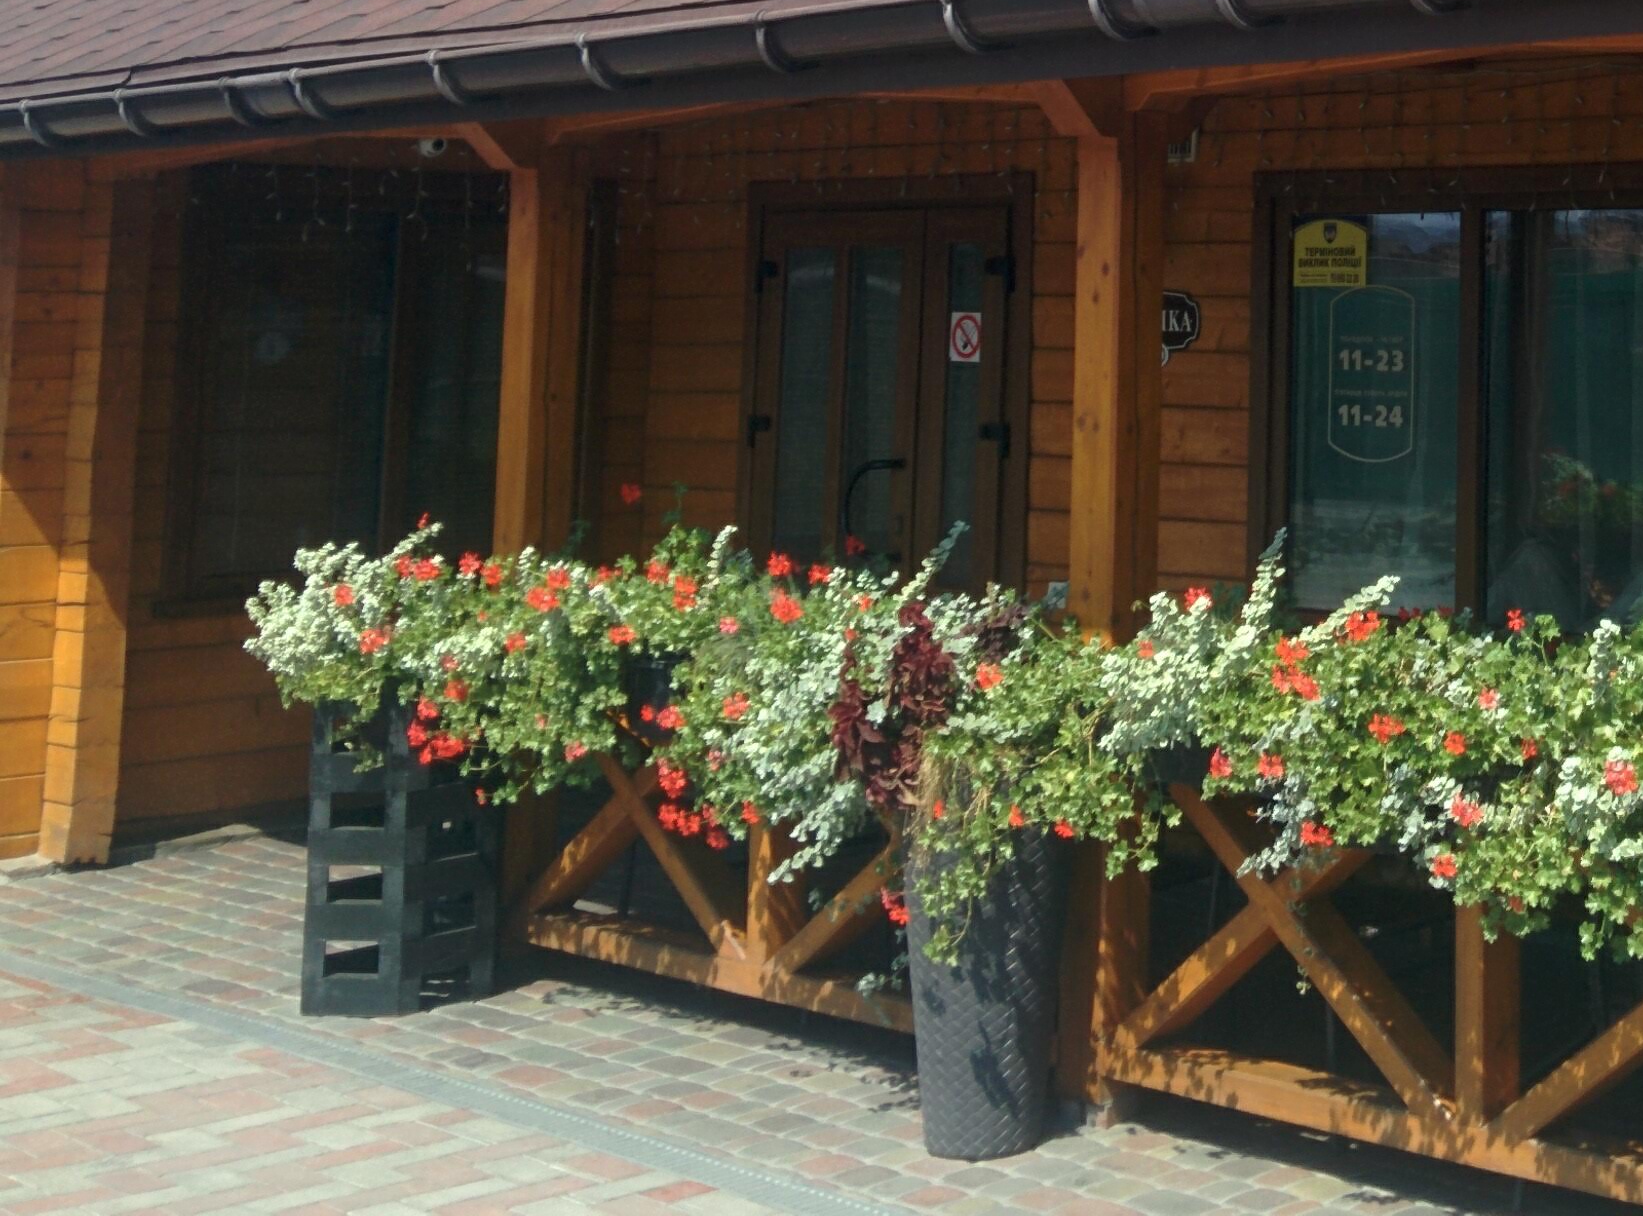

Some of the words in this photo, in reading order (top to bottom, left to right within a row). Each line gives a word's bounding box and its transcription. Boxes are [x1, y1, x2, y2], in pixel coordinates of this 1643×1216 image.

[1305, 245, 1356, 256] ТЕРМІНОВИЙ
[1298, 258, 1330, 268] ВИКЛИК
[1331, 256, 1362, 268] ПОЛІЦІЇ
[1338, 349, 1404, 372] 11-23
[1338, 404, 1404, 428] 11-24
